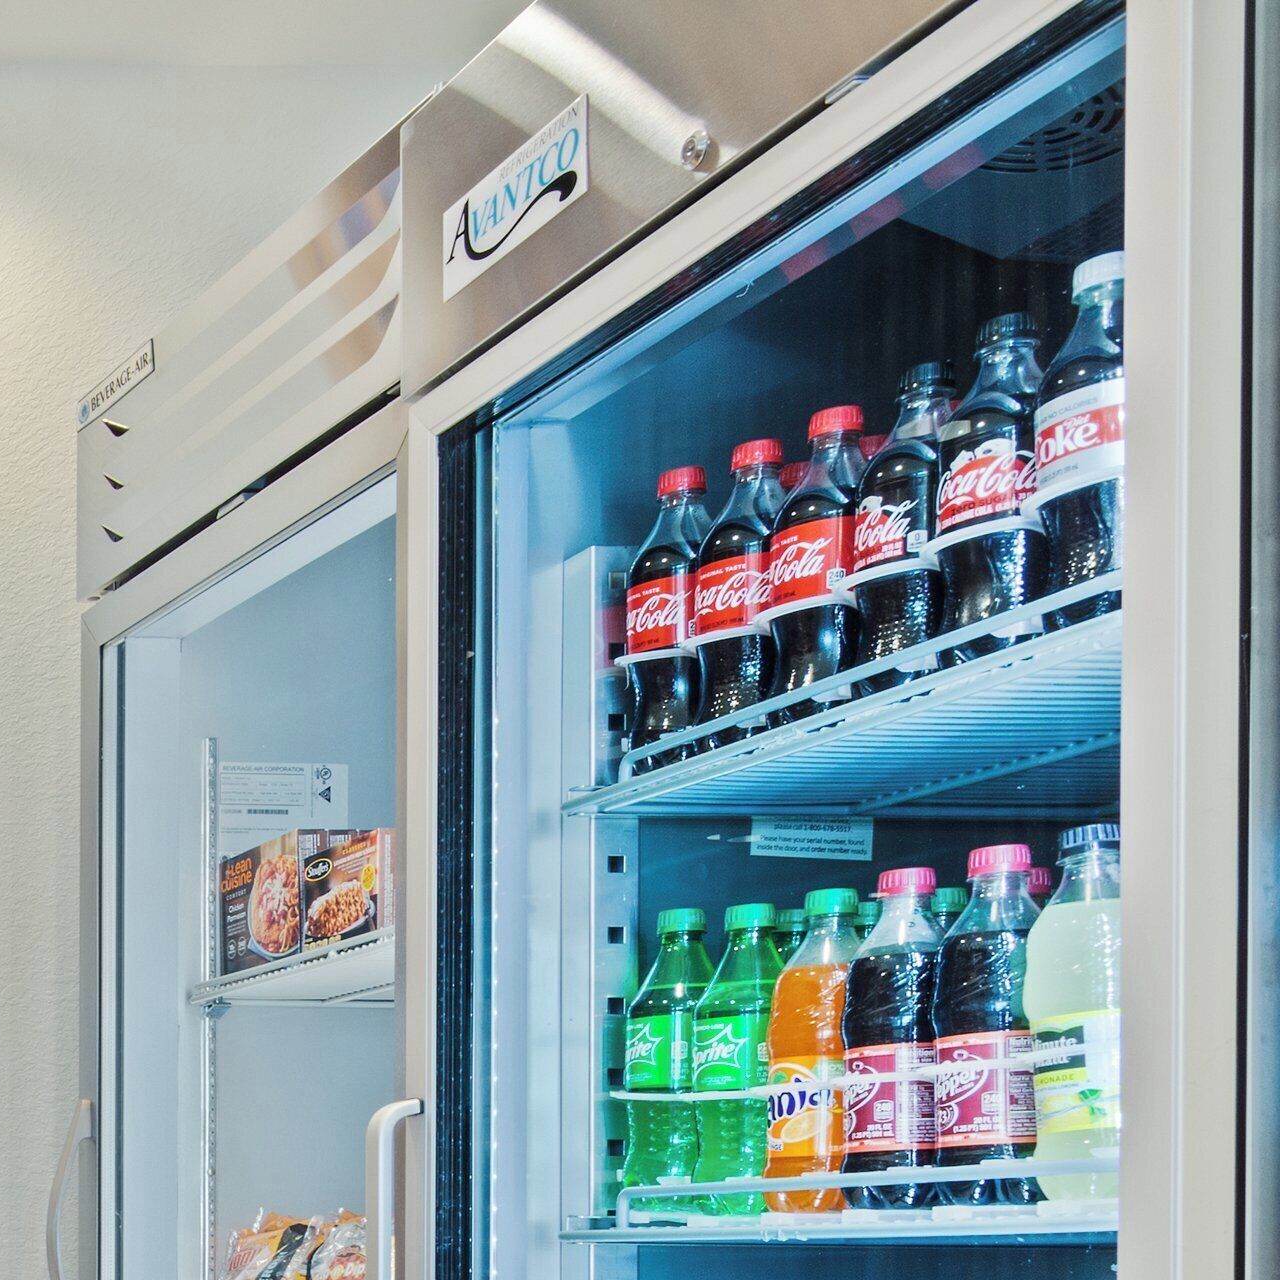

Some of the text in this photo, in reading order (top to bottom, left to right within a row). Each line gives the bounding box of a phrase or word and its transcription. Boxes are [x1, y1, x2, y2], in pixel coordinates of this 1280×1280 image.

[499, 106, 578, 182] REFRIGERATION
[446, 128, 580, 265] AVANTCO
[90, 352, 149, 411] BEVERAGE-AIR
[1064, 414, 1089, 433] Diet
[627, 1041, 653, 1061] rite
